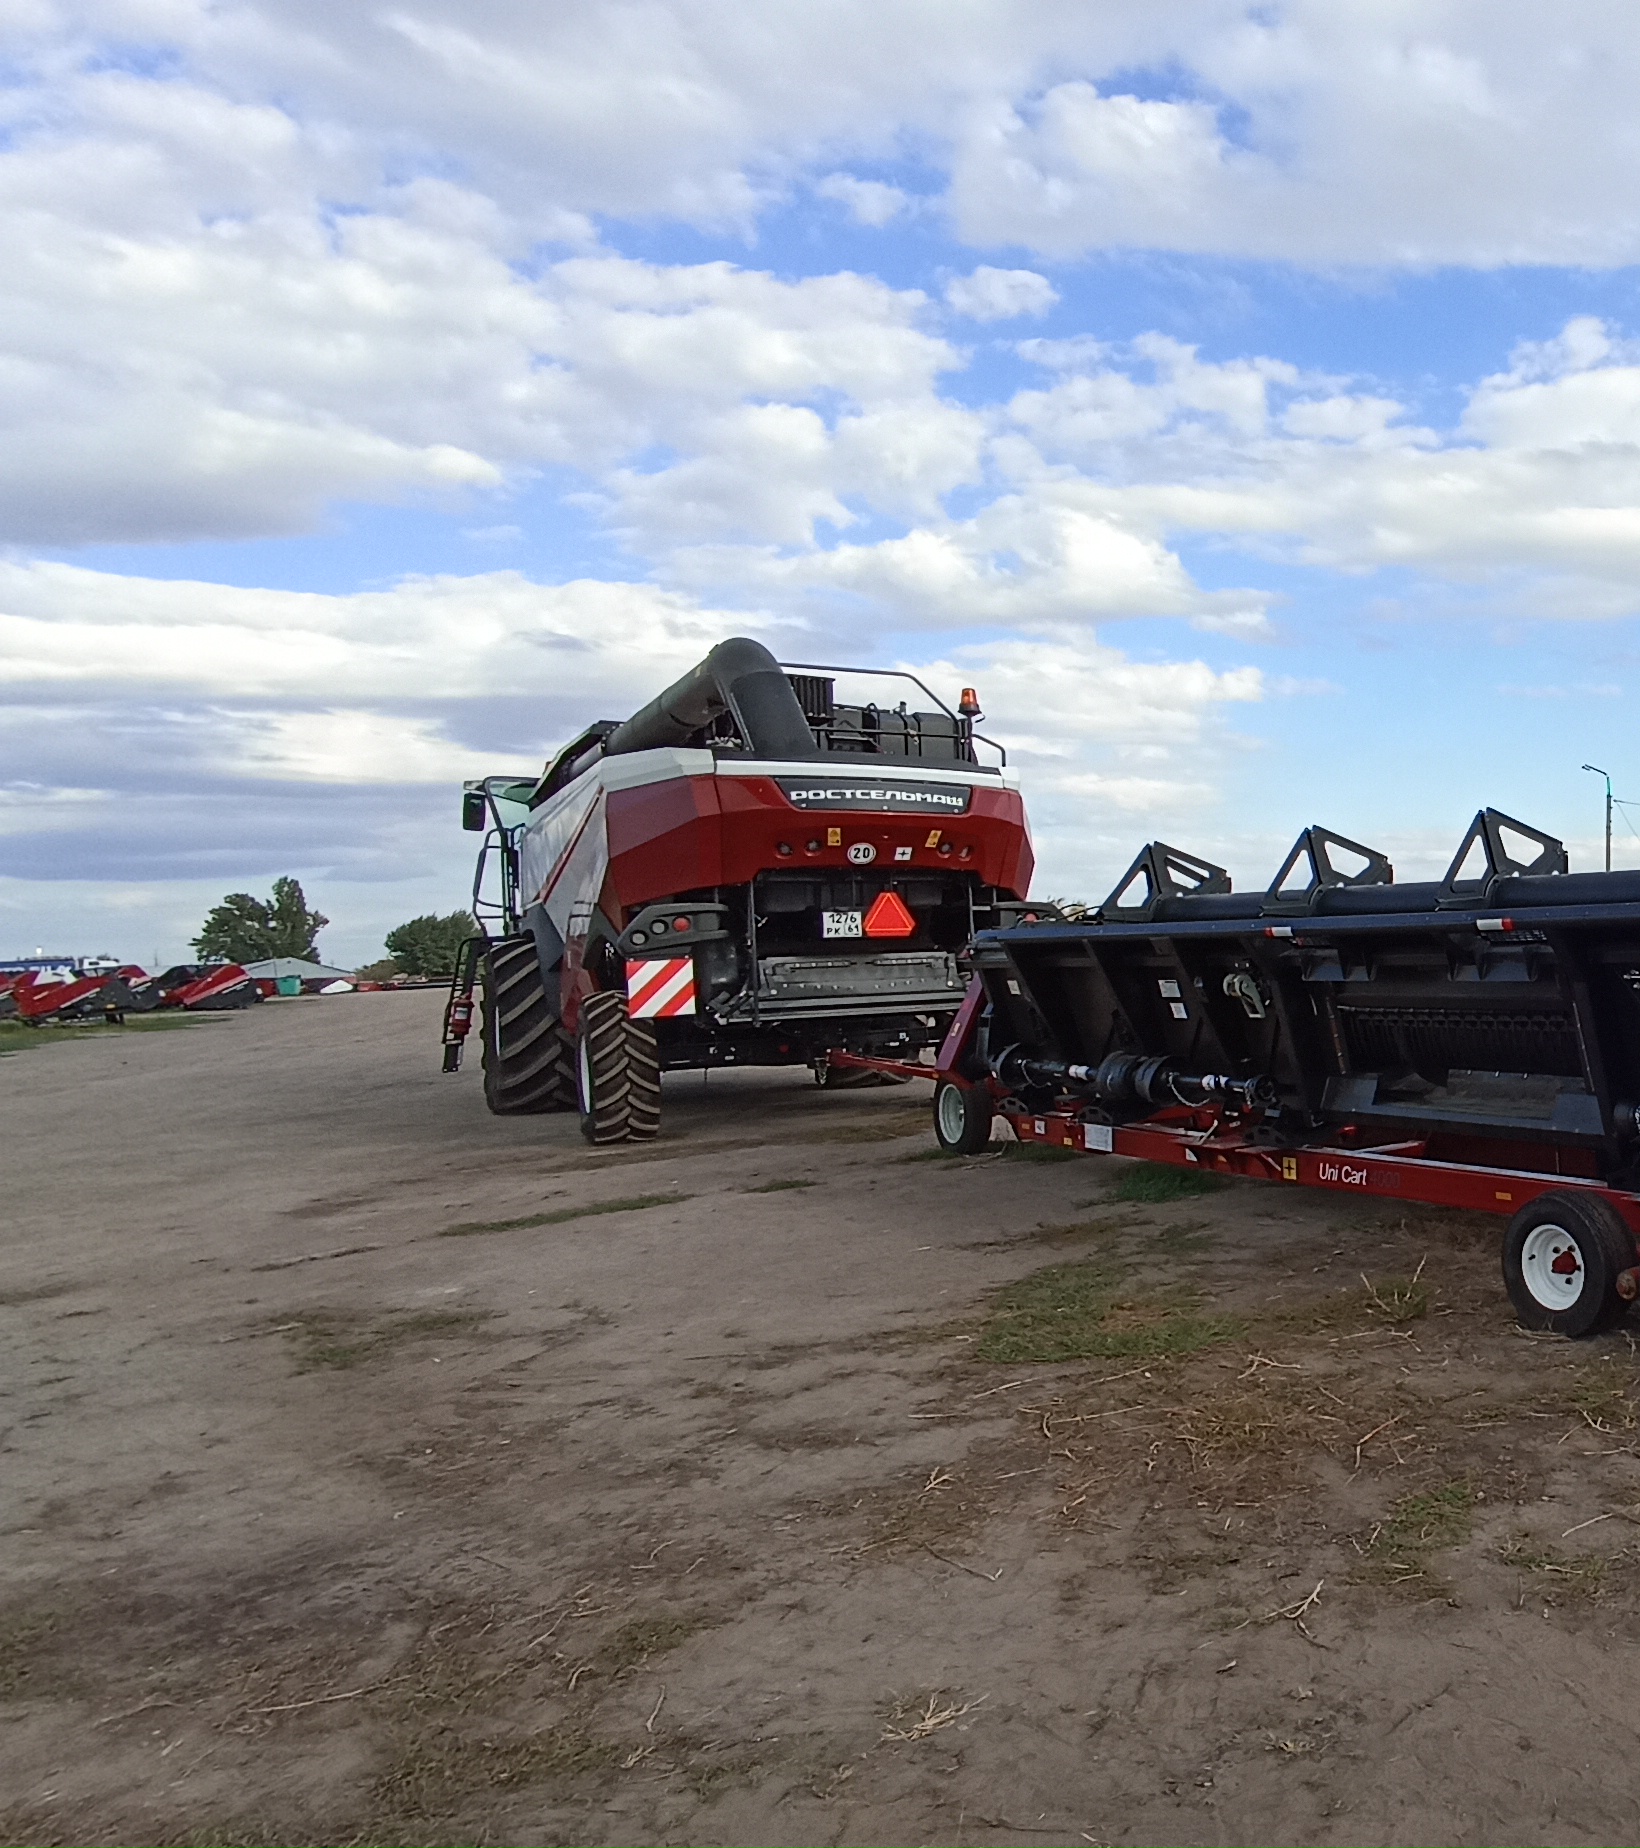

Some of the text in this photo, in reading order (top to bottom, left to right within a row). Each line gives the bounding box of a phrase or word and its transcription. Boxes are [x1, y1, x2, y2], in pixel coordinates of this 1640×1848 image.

[790, 789, 964, 806] РОСТСЕЛЬМАШ
[853, 847, 870, 859] 20
[829, 913, 857, 923] 1276
[1319, 1162, 1338, 1181] Uni
[1341, 1165, 1367, 1186] Cart
